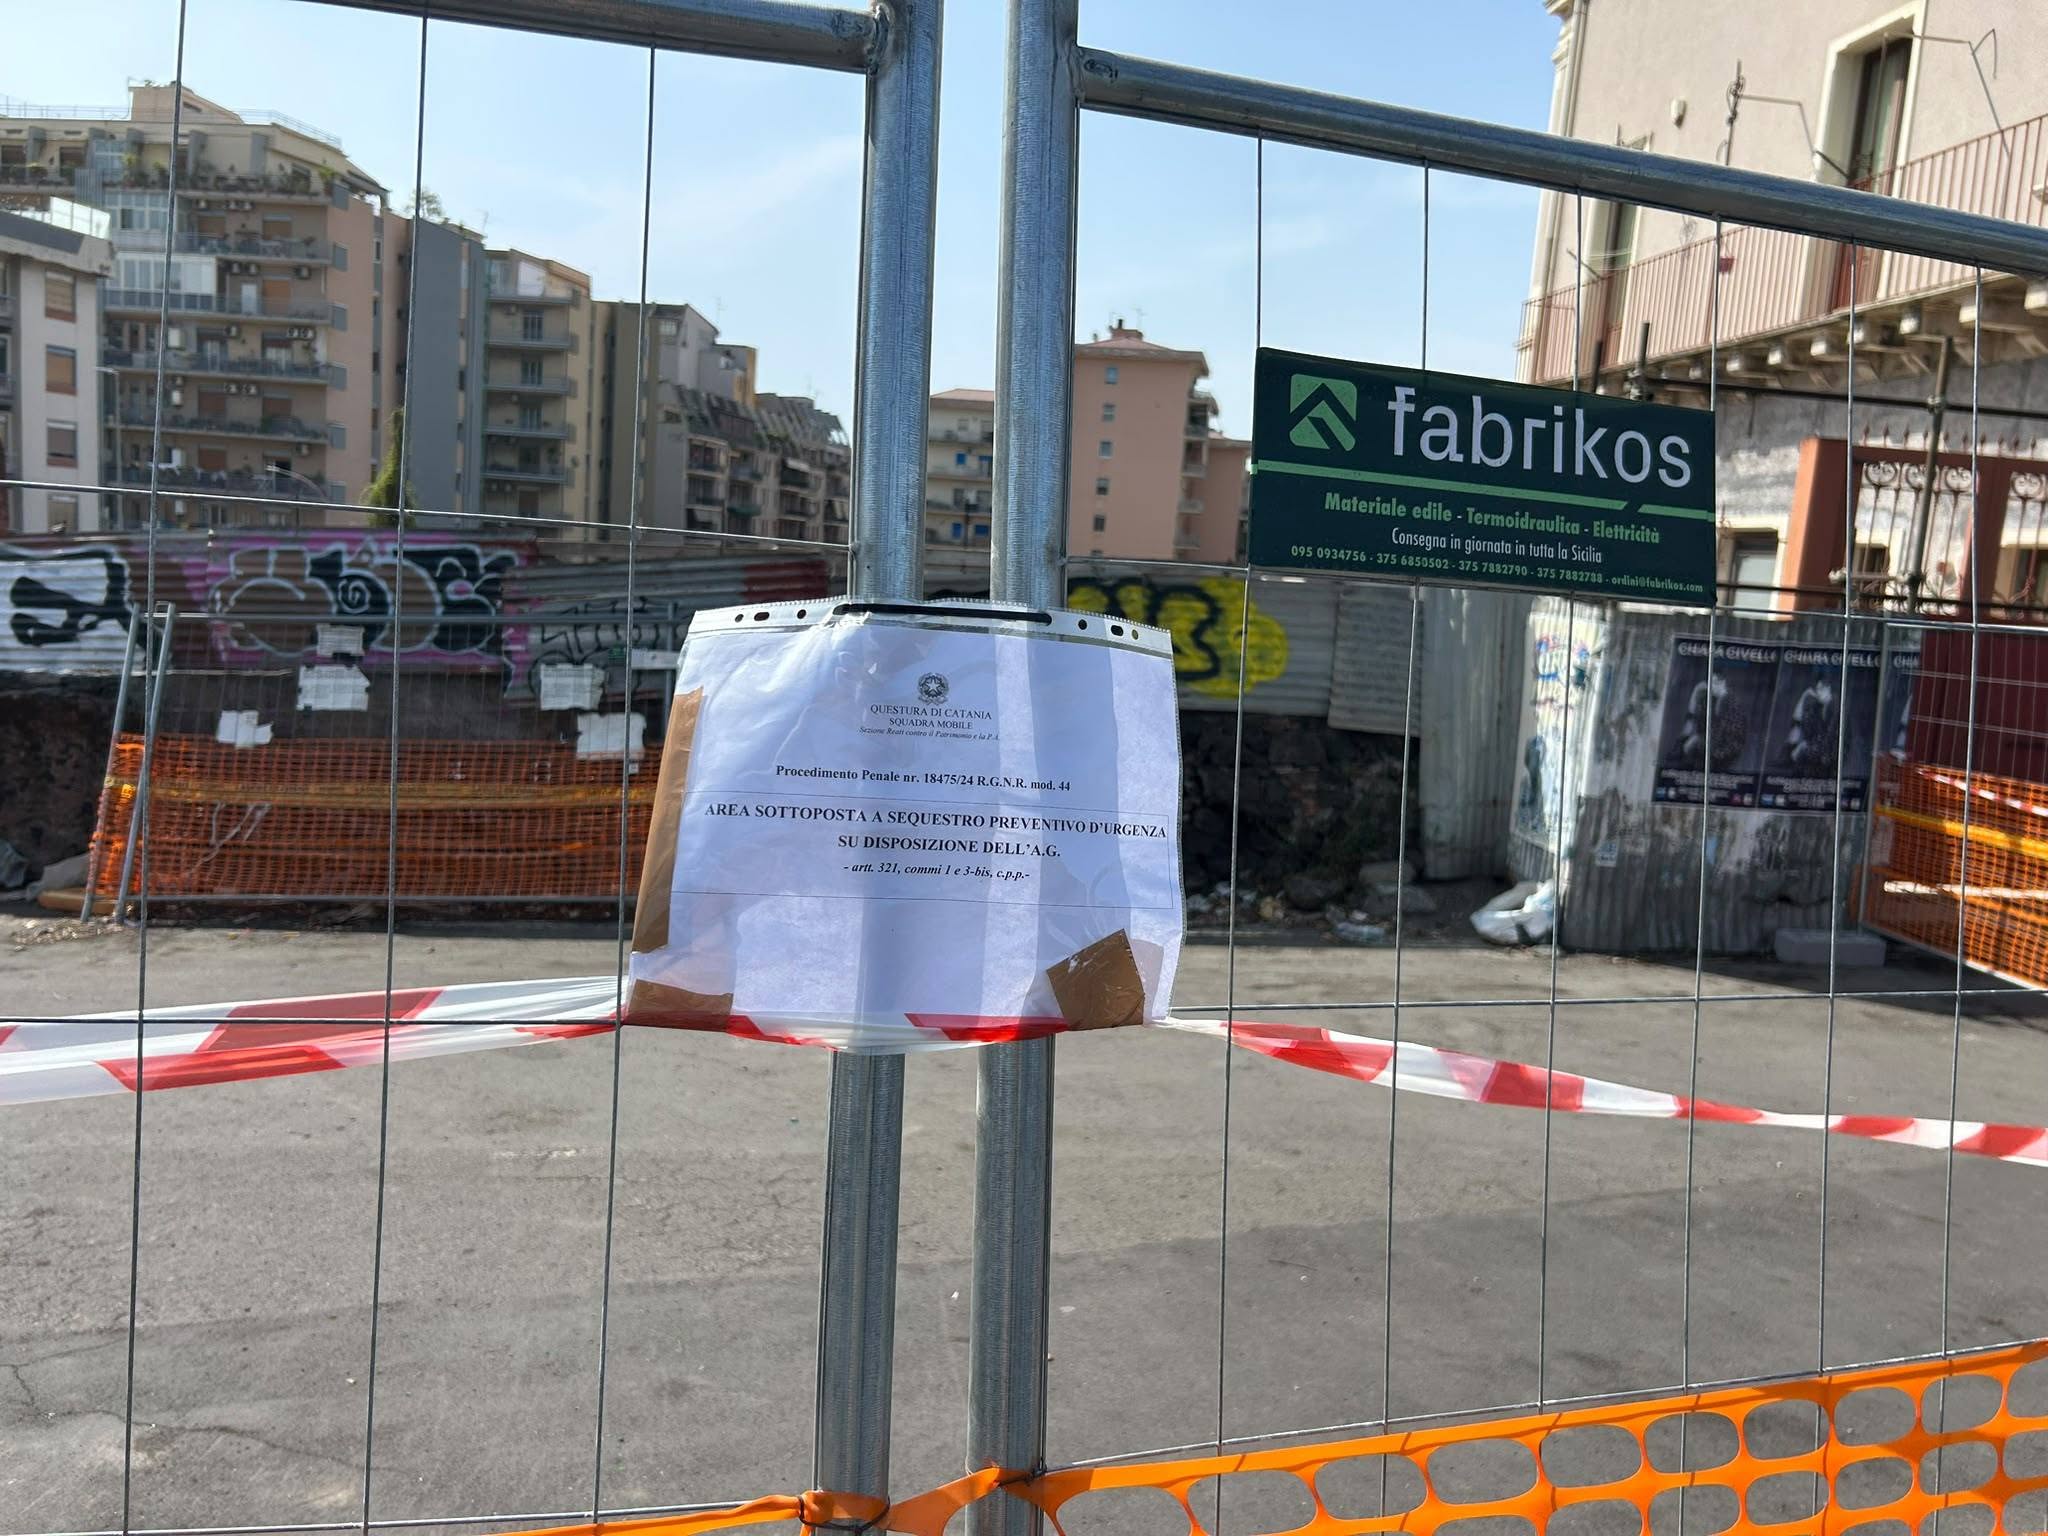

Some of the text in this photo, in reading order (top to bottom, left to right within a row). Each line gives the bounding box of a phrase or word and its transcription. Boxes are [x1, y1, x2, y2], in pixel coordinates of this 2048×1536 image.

[1387, 386, 1693, 488] fabrikos
[1324, 492, 1407, 517] Materiale
[1412, 501, 1452, 521] edile
[1466, 507, 1580, 535] Termoidraulica
[1592, 520, 1660, 543] Elettricità
[1391, 527, 1602, 564] Consegna in giornata in tutta la Sicilia
[1291, 545, 1313, 557] 095
[1317, 547, 1366, 562] 0934756
[1376, 553, 1397, 565] 375
[1458, 560, 1478, 572] 375
[1537, 567, 1556, 578] 375
[1678, 642, 1724, 657] CHIAA
[1831, 651, 1880, 668] CIELL
[870, 704, 992, 720] QUESTURA DI CATANIA
[889, 717, 973, 730] SQUADRA MOBILE
[776, 765, 1070, 791] Procedimento Penale nr. 18475/24 R.G.N.R. mod. 44
[705, 803, 750, 817] AREA
[755, 805, 867, 822] SOTTOPOSTA
[872, 811, 883, 823] A
[887, 810, 985, 828] SEQUESTRO
[989, 815, 1086, 833] PREVENTIVO
[838, 835, 859, 848] SU
[863, 836, 978, 853] DISPOSIZIONE
[851, 862, 874, 873] artt.
[877, 862, 901, 875] 321,
[904, 864, 942, 875] commi
[945, 864, 951, 875] 1
[954, 867, 961, 876] e
[963, 865, 993, 879] 3-bis,
